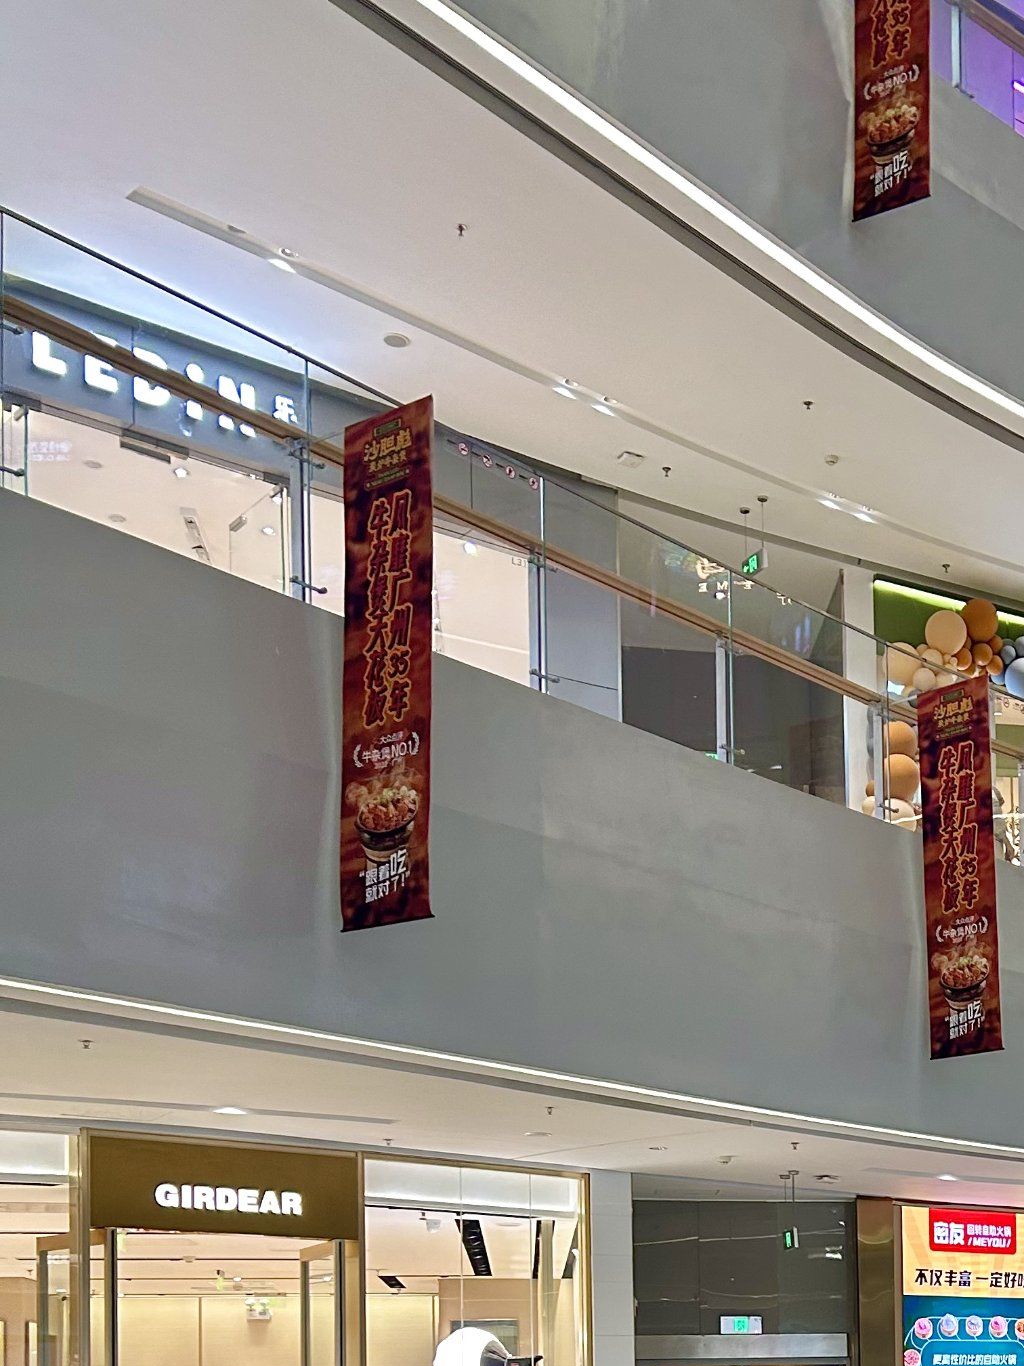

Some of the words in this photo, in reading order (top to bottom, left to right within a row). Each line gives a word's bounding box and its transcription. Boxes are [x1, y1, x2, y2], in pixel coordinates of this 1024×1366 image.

[155, 1184, 303, 1216] GIRDEAR
[933, 1221, 965, 1245] 密友
[915, 1268, 972, 1287] 不仅丰富
